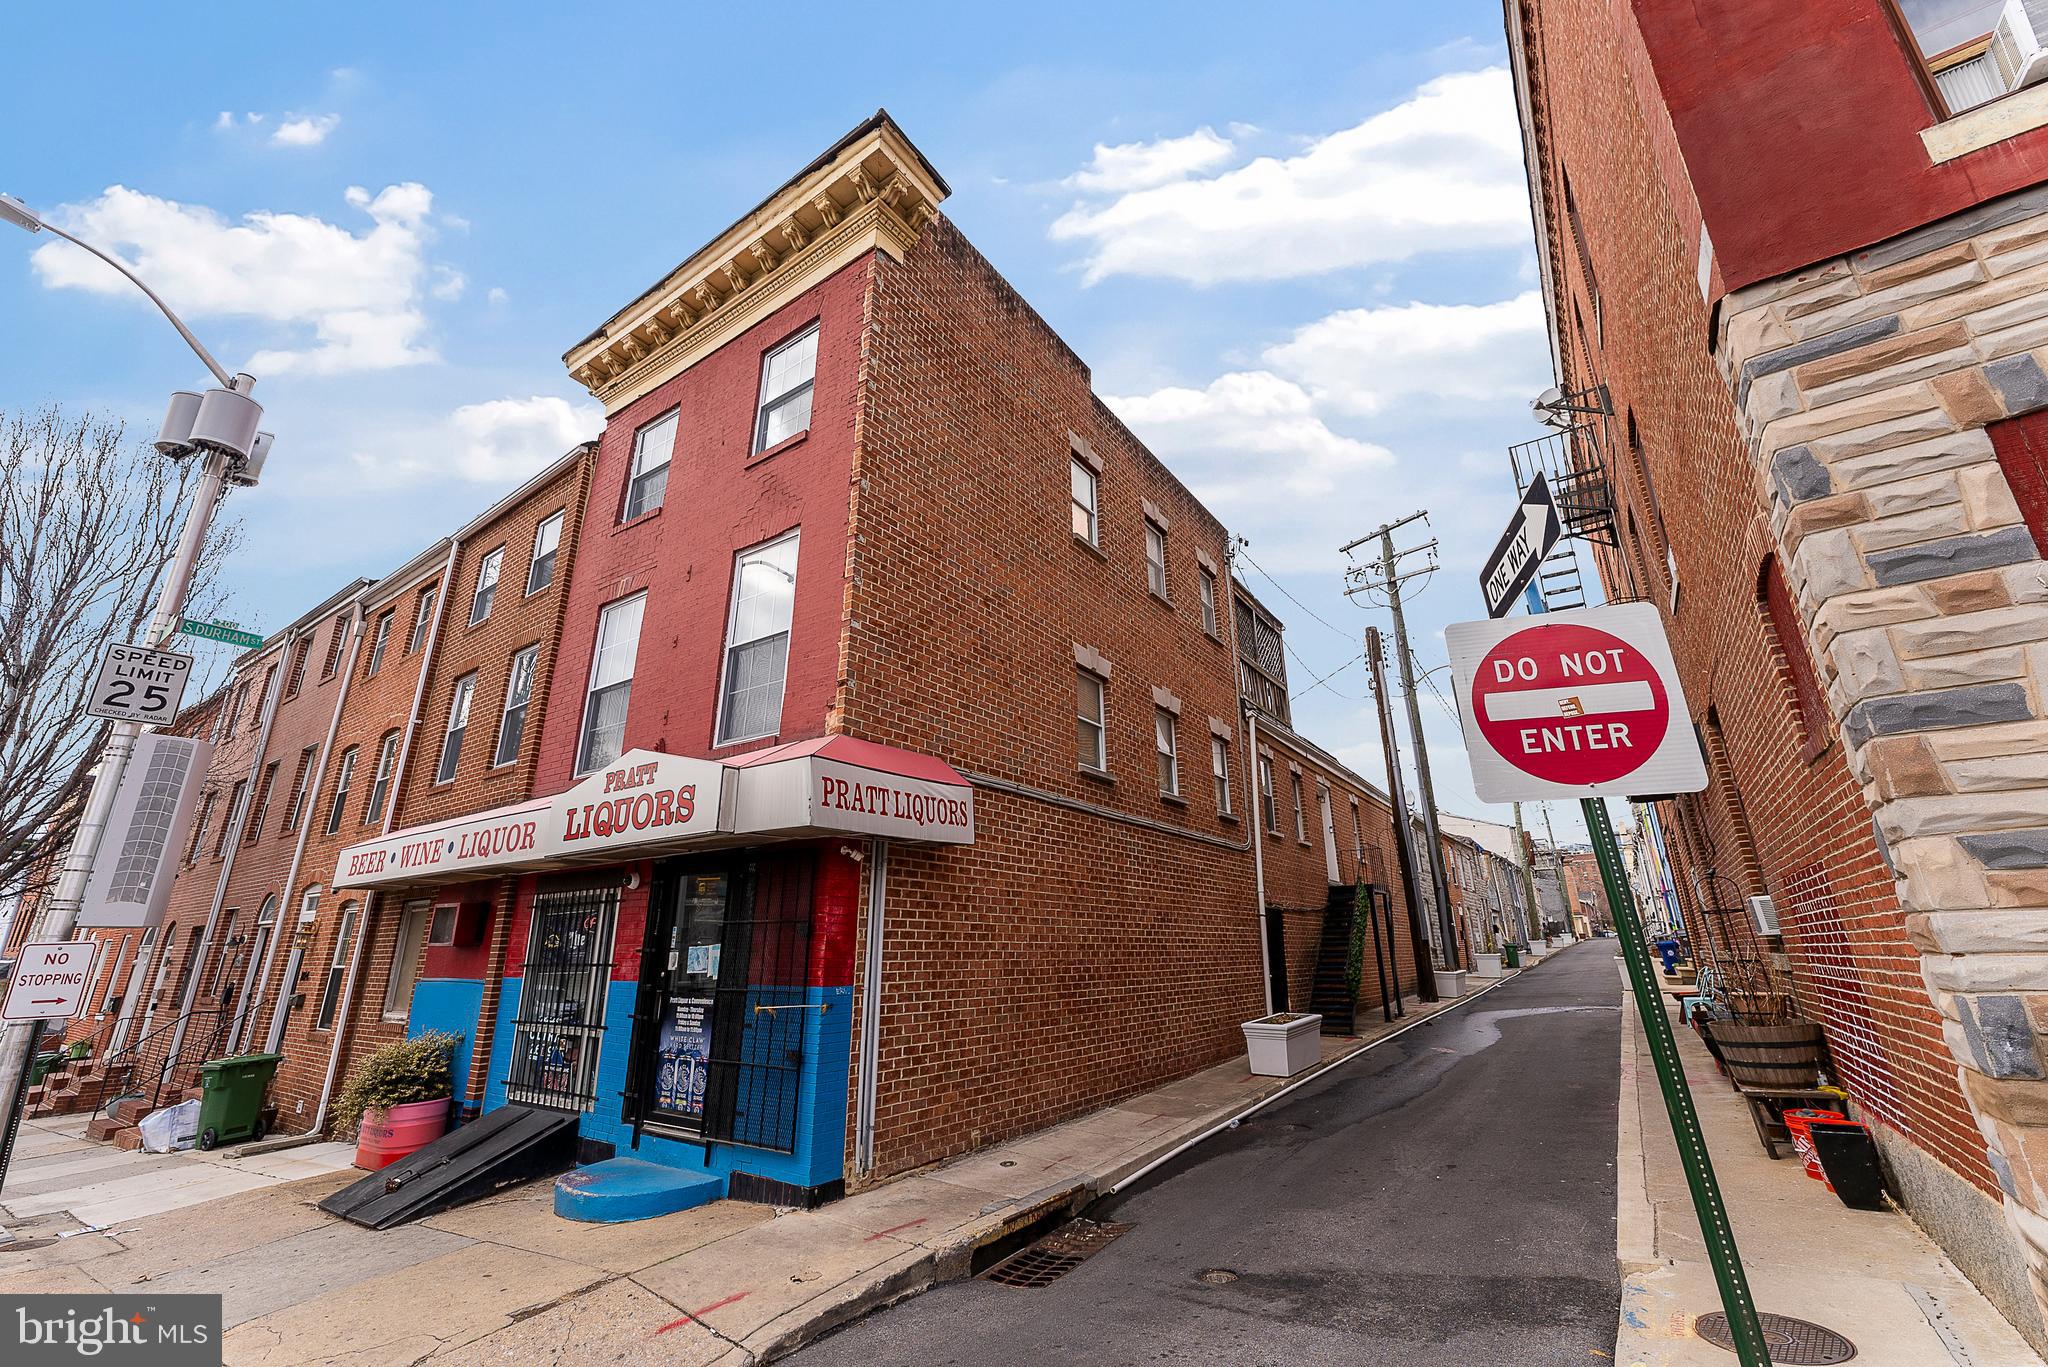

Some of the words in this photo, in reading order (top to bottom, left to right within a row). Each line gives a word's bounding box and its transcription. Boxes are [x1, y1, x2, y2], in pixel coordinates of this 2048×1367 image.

[1490, 562, 1510, 603] ONE
[1507, 526, 1529, 575] WAY
[112, 649, 187, 670] SPEED
[115, 665, 175, 683] LIMIT
[1494, 657, 1538, 683] DO
[1560, 649, 1624, 677] NOT
[103, 680, 170, 711] 25
[94, 708, 127, 717] CHECKED
[143, 714, 168, 722] RADAR
[1520, 723, 1633, 754] ENTER
[604, 762, 658, 793] PRATT
[563, 784, 696, 841] LIQUORS
[822, 776, 890, 816] PRATT
[894, 790, 968, 827] LIQUORS
[348, 850, 387, 877] BEER
[400, 839, 444, 868] WINE
[457, 822, 536, 859] LIQUOR
[44, 953, 69, 965] NO
[18, 973, 82, 987] STOPPING
